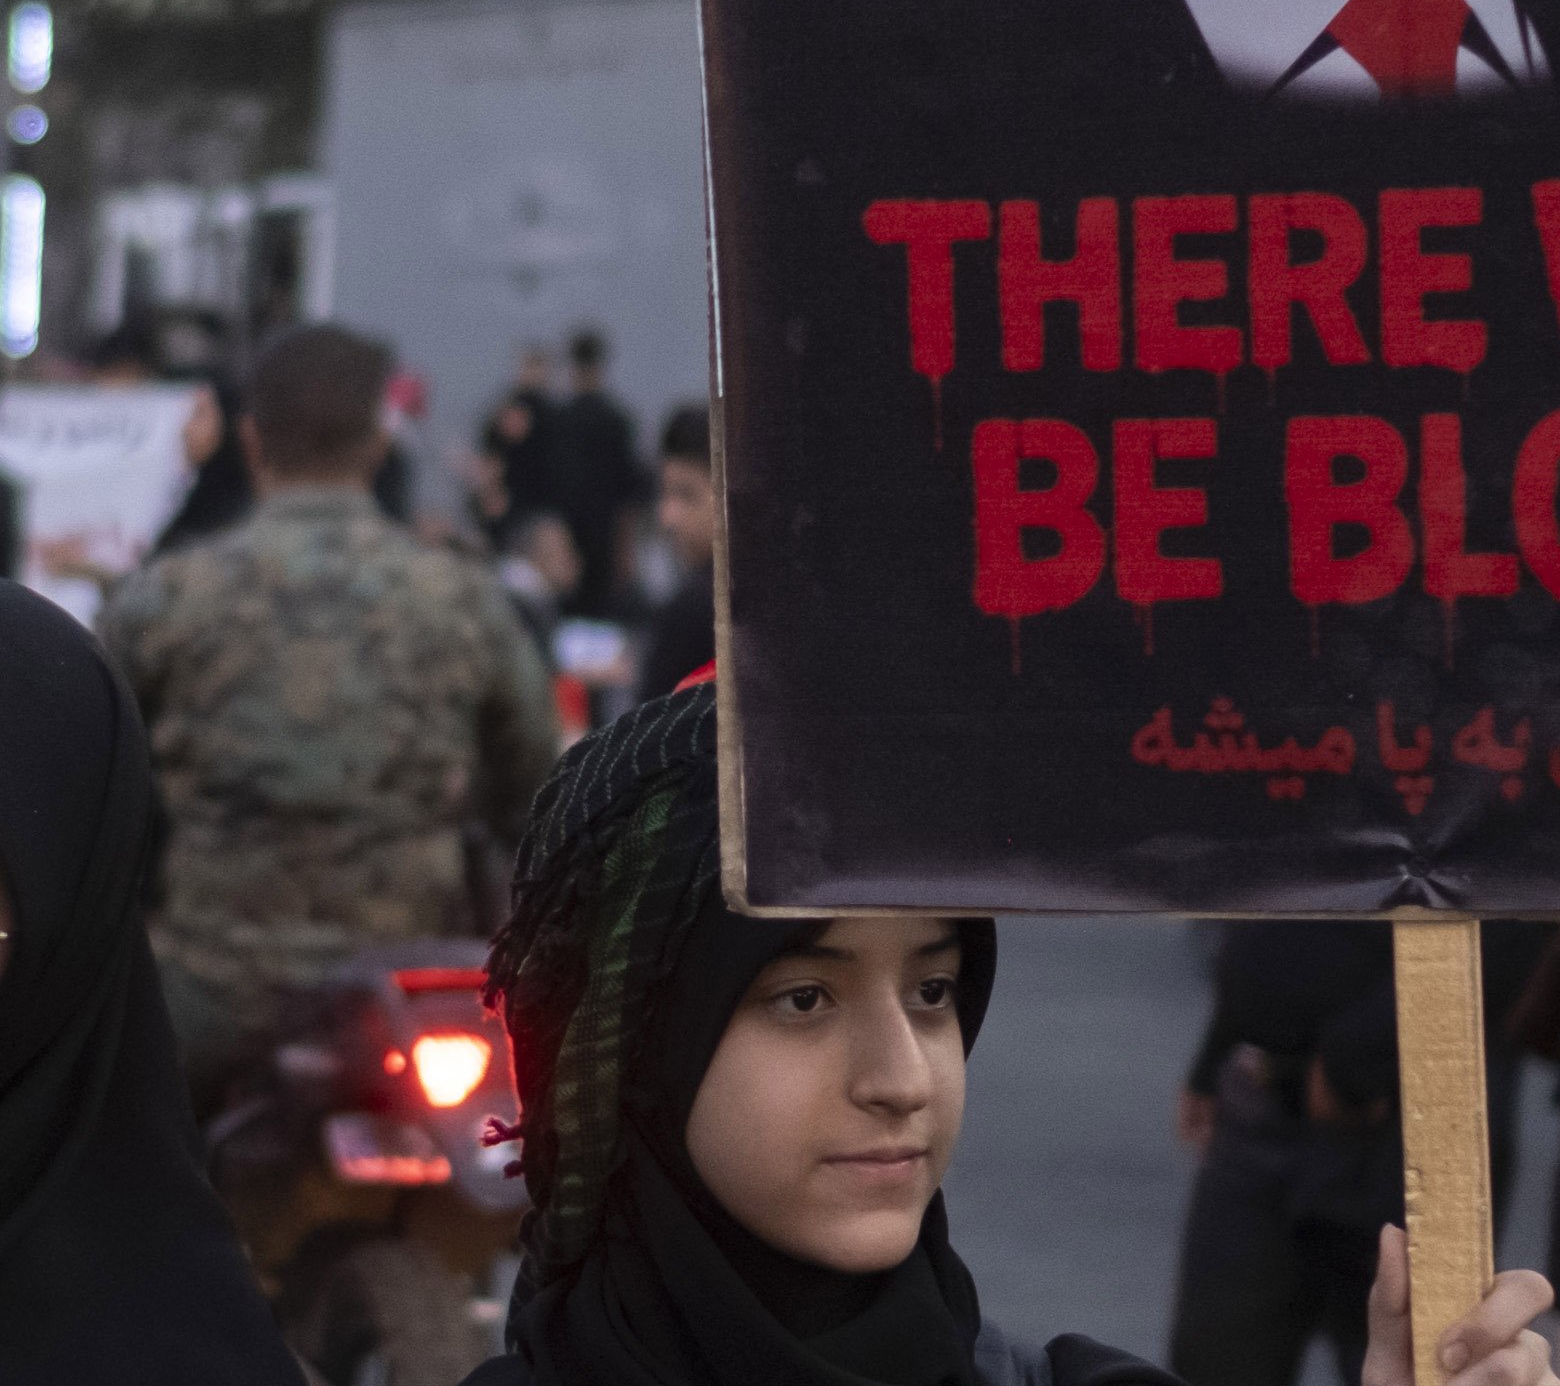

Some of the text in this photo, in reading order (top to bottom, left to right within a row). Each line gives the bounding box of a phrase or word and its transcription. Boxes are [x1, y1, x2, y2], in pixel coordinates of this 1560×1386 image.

[863, 187, 1488, 383] THERE
[971, 417, 1224, 621] BE
[1130, 697, 1357, 801] میشه
[1378, 700, 1433, 814] پا
[1452, 705, 1531, 801] به
